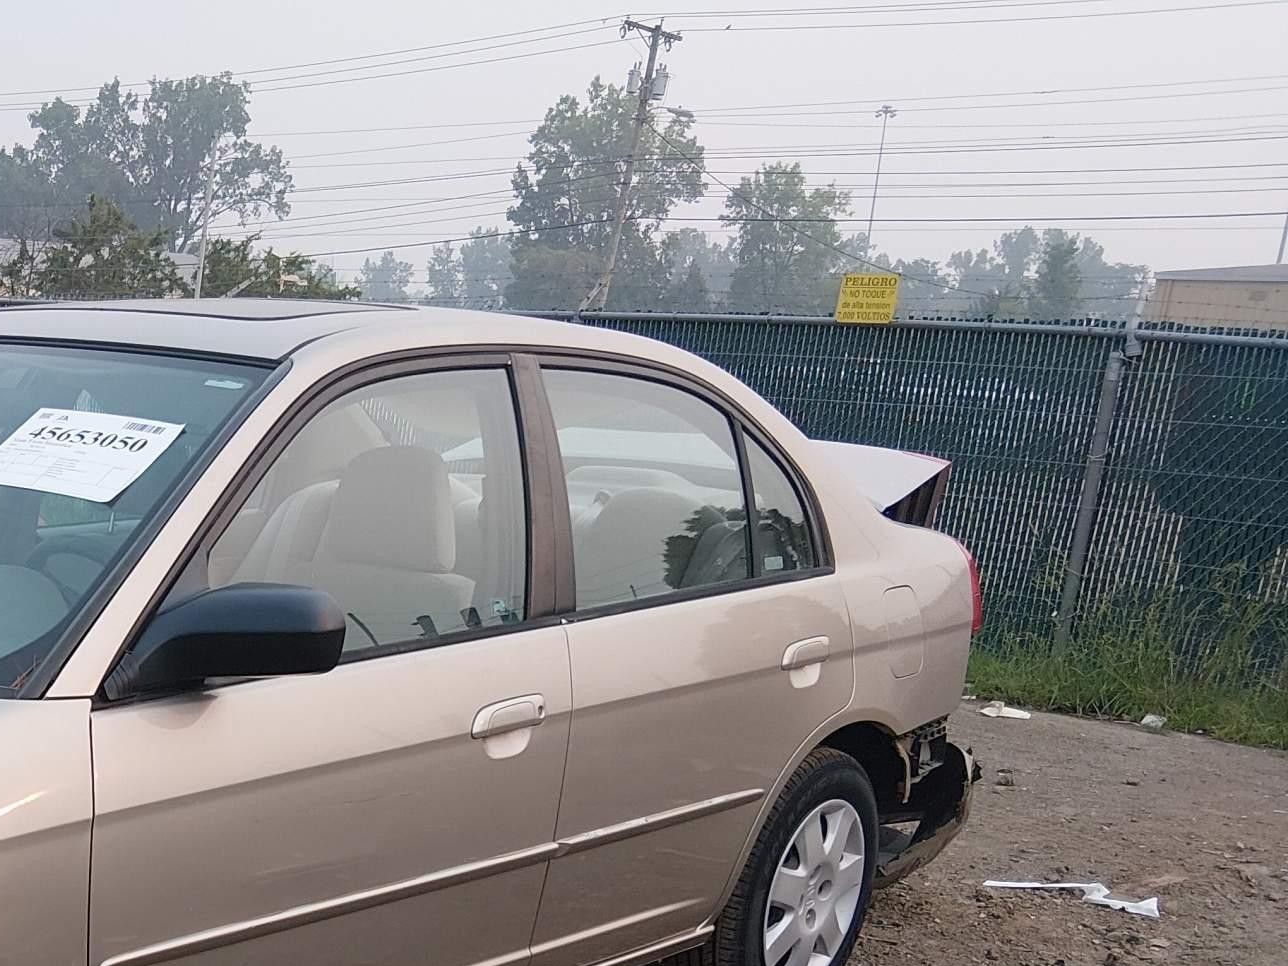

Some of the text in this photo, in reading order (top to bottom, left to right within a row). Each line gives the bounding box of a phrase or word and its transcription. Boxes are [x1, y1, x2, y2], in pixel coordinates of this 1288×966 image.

[844, 277, 897, 287] PELIGRO
[849, 289, 887, 299] NO TOQUE
[856, 311, 891, 320] VOLTIOS
[29, 425, 149, 453] 45653050
